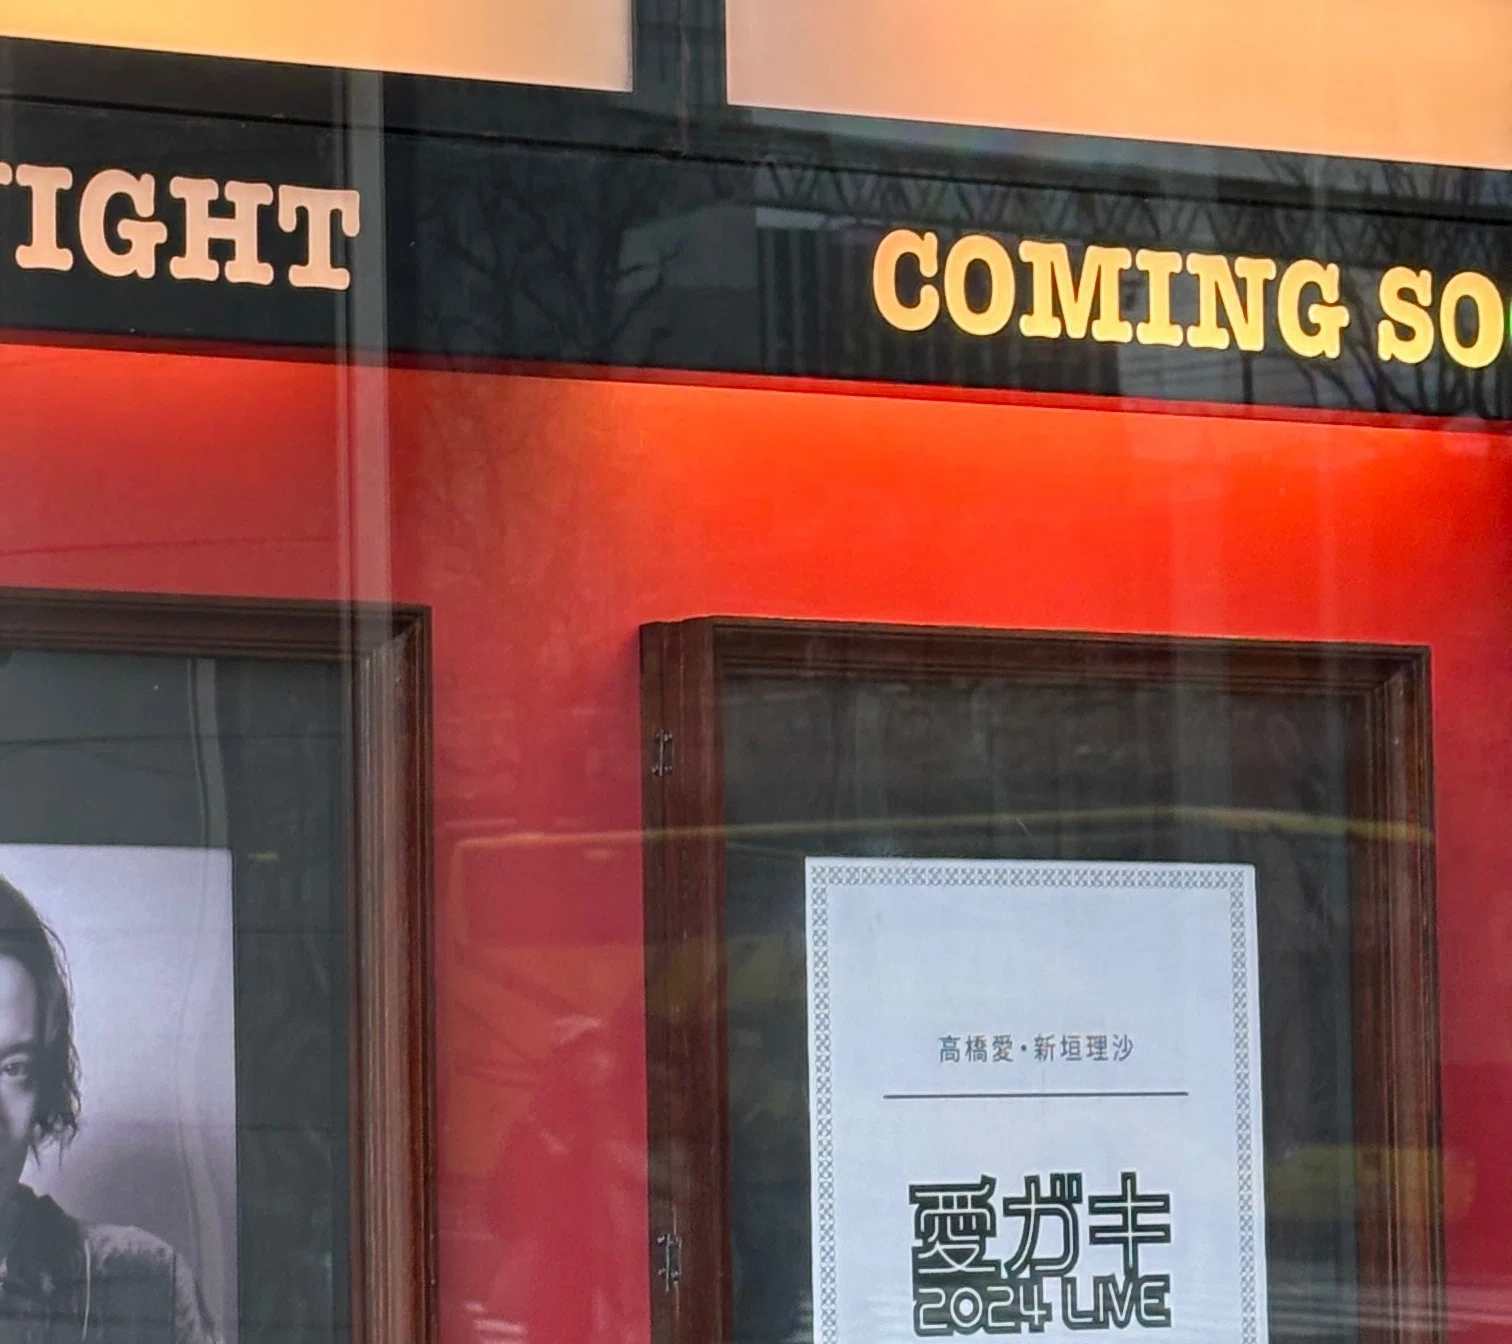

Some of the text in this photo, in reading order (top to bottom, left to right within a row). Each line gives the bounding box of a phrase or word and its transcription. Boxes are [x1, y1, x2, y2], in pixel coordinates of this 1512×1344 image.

[872, 229, 1350, 358] COMING
[908, 1171, 1171, 1279] 愛ガキ
[914, 1273, 1172, 1337] 2024 LIVE
